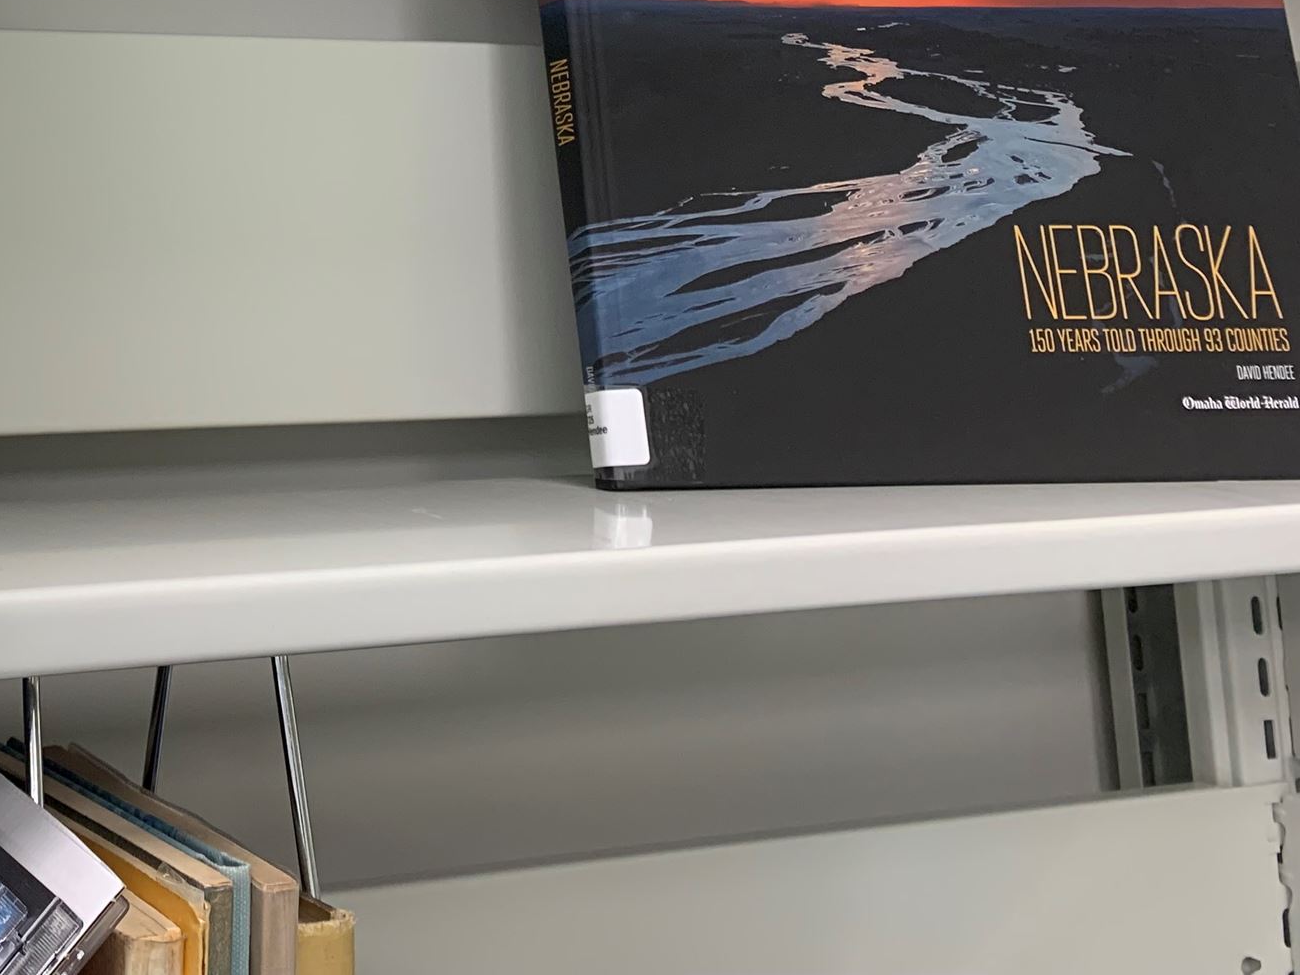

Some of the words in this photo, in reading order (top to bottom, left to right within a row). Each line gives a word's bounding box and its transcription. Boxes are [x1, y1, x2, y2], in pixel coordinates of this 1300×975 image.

[550, 58, 575, 146] NEBRASKA
[1014, 223, 1283, 320] NEBRASKA
[1029, 329, 1055, 353] 150
[1059, 329, 1101, 353] YEARS
[1103, 329, 1137, 352] TOLD
[1140, 328, 1201, 352] THROUGH
[1204, 328, 1223, 352] 93
[1227, 328, 1290, 352] COUNTIES
[1236, 365, 1260, 380] DAVID
[1262, 365, 1295, 380] HENDEE
[1182, 396, 1223, 410] Omaha
[1224, 395, 1300, 410] World-Herald
